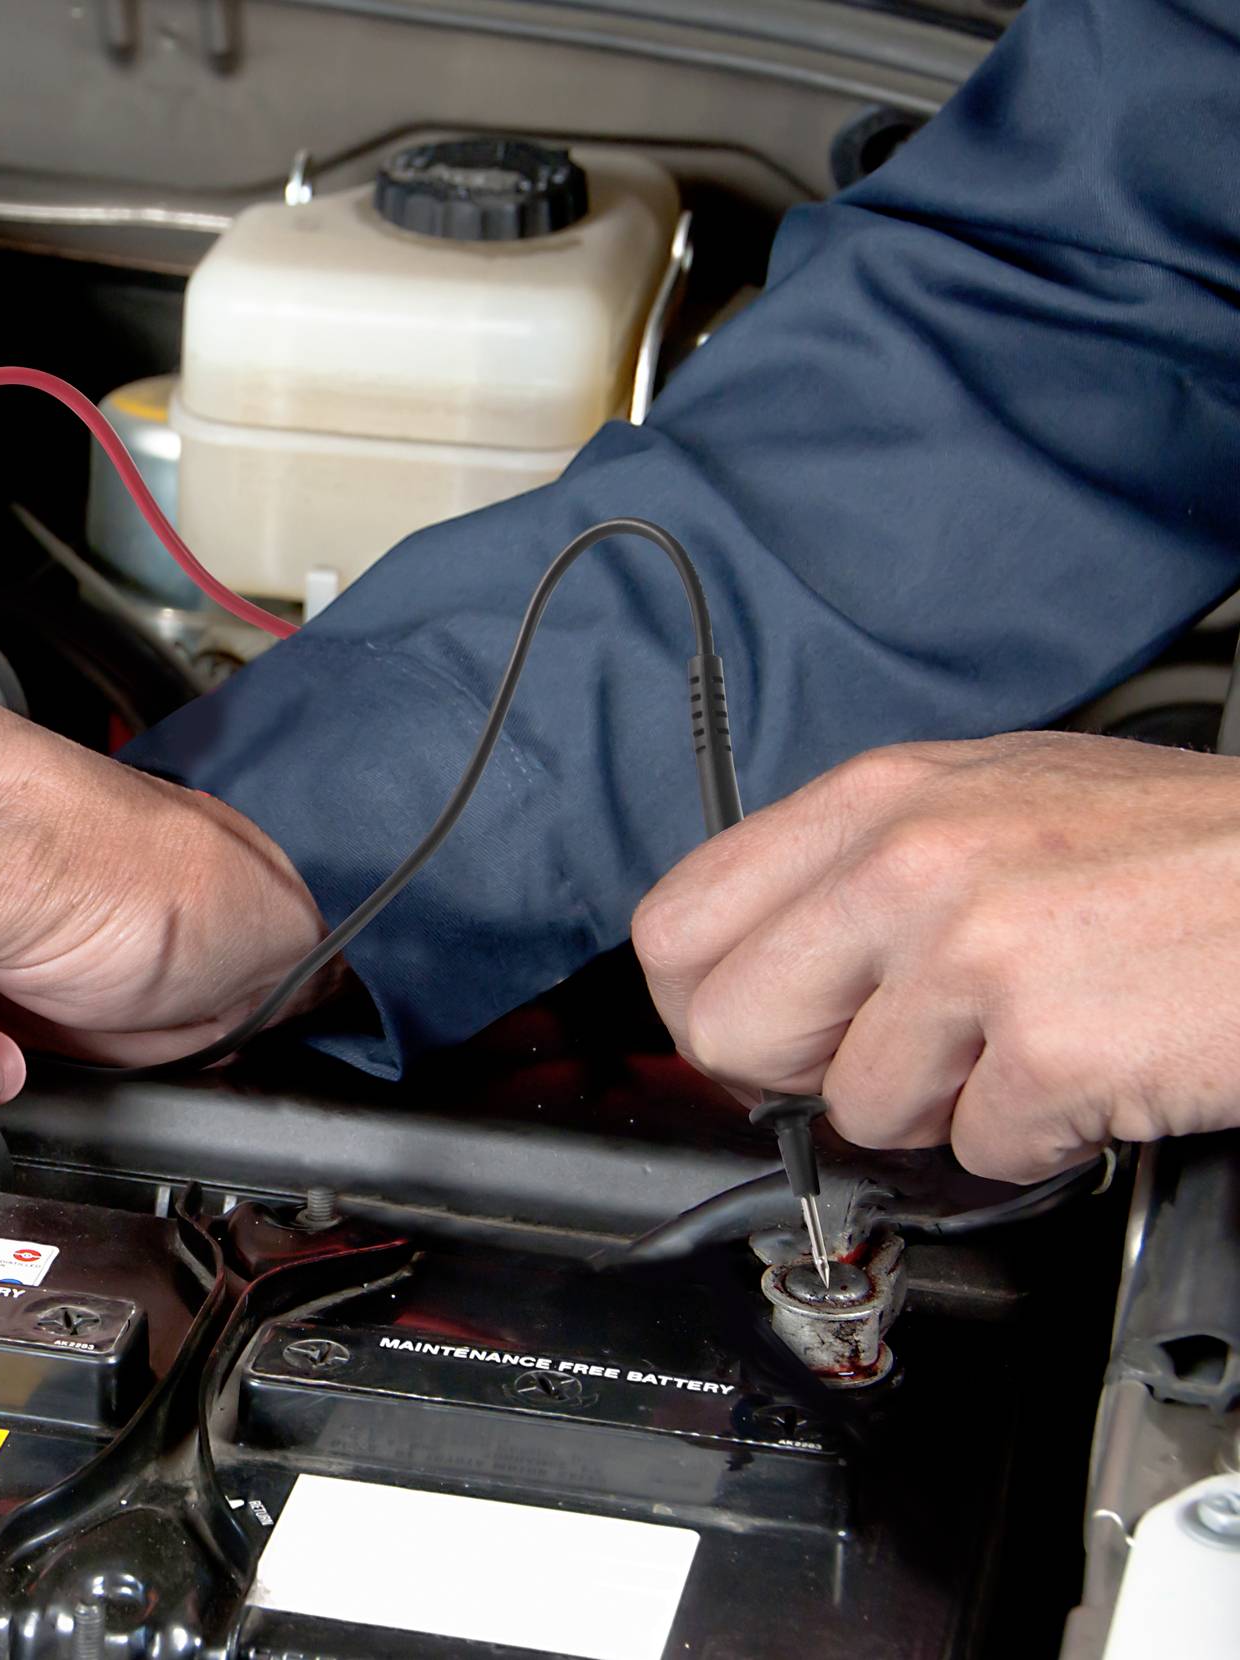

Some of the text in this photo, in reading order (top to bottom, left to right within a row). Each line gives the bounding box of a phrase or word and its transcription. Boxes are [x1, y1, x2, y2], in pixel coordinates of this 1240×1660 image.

[379, 1336, 735, 1396] MAINTENANCE FREE BATTERY
